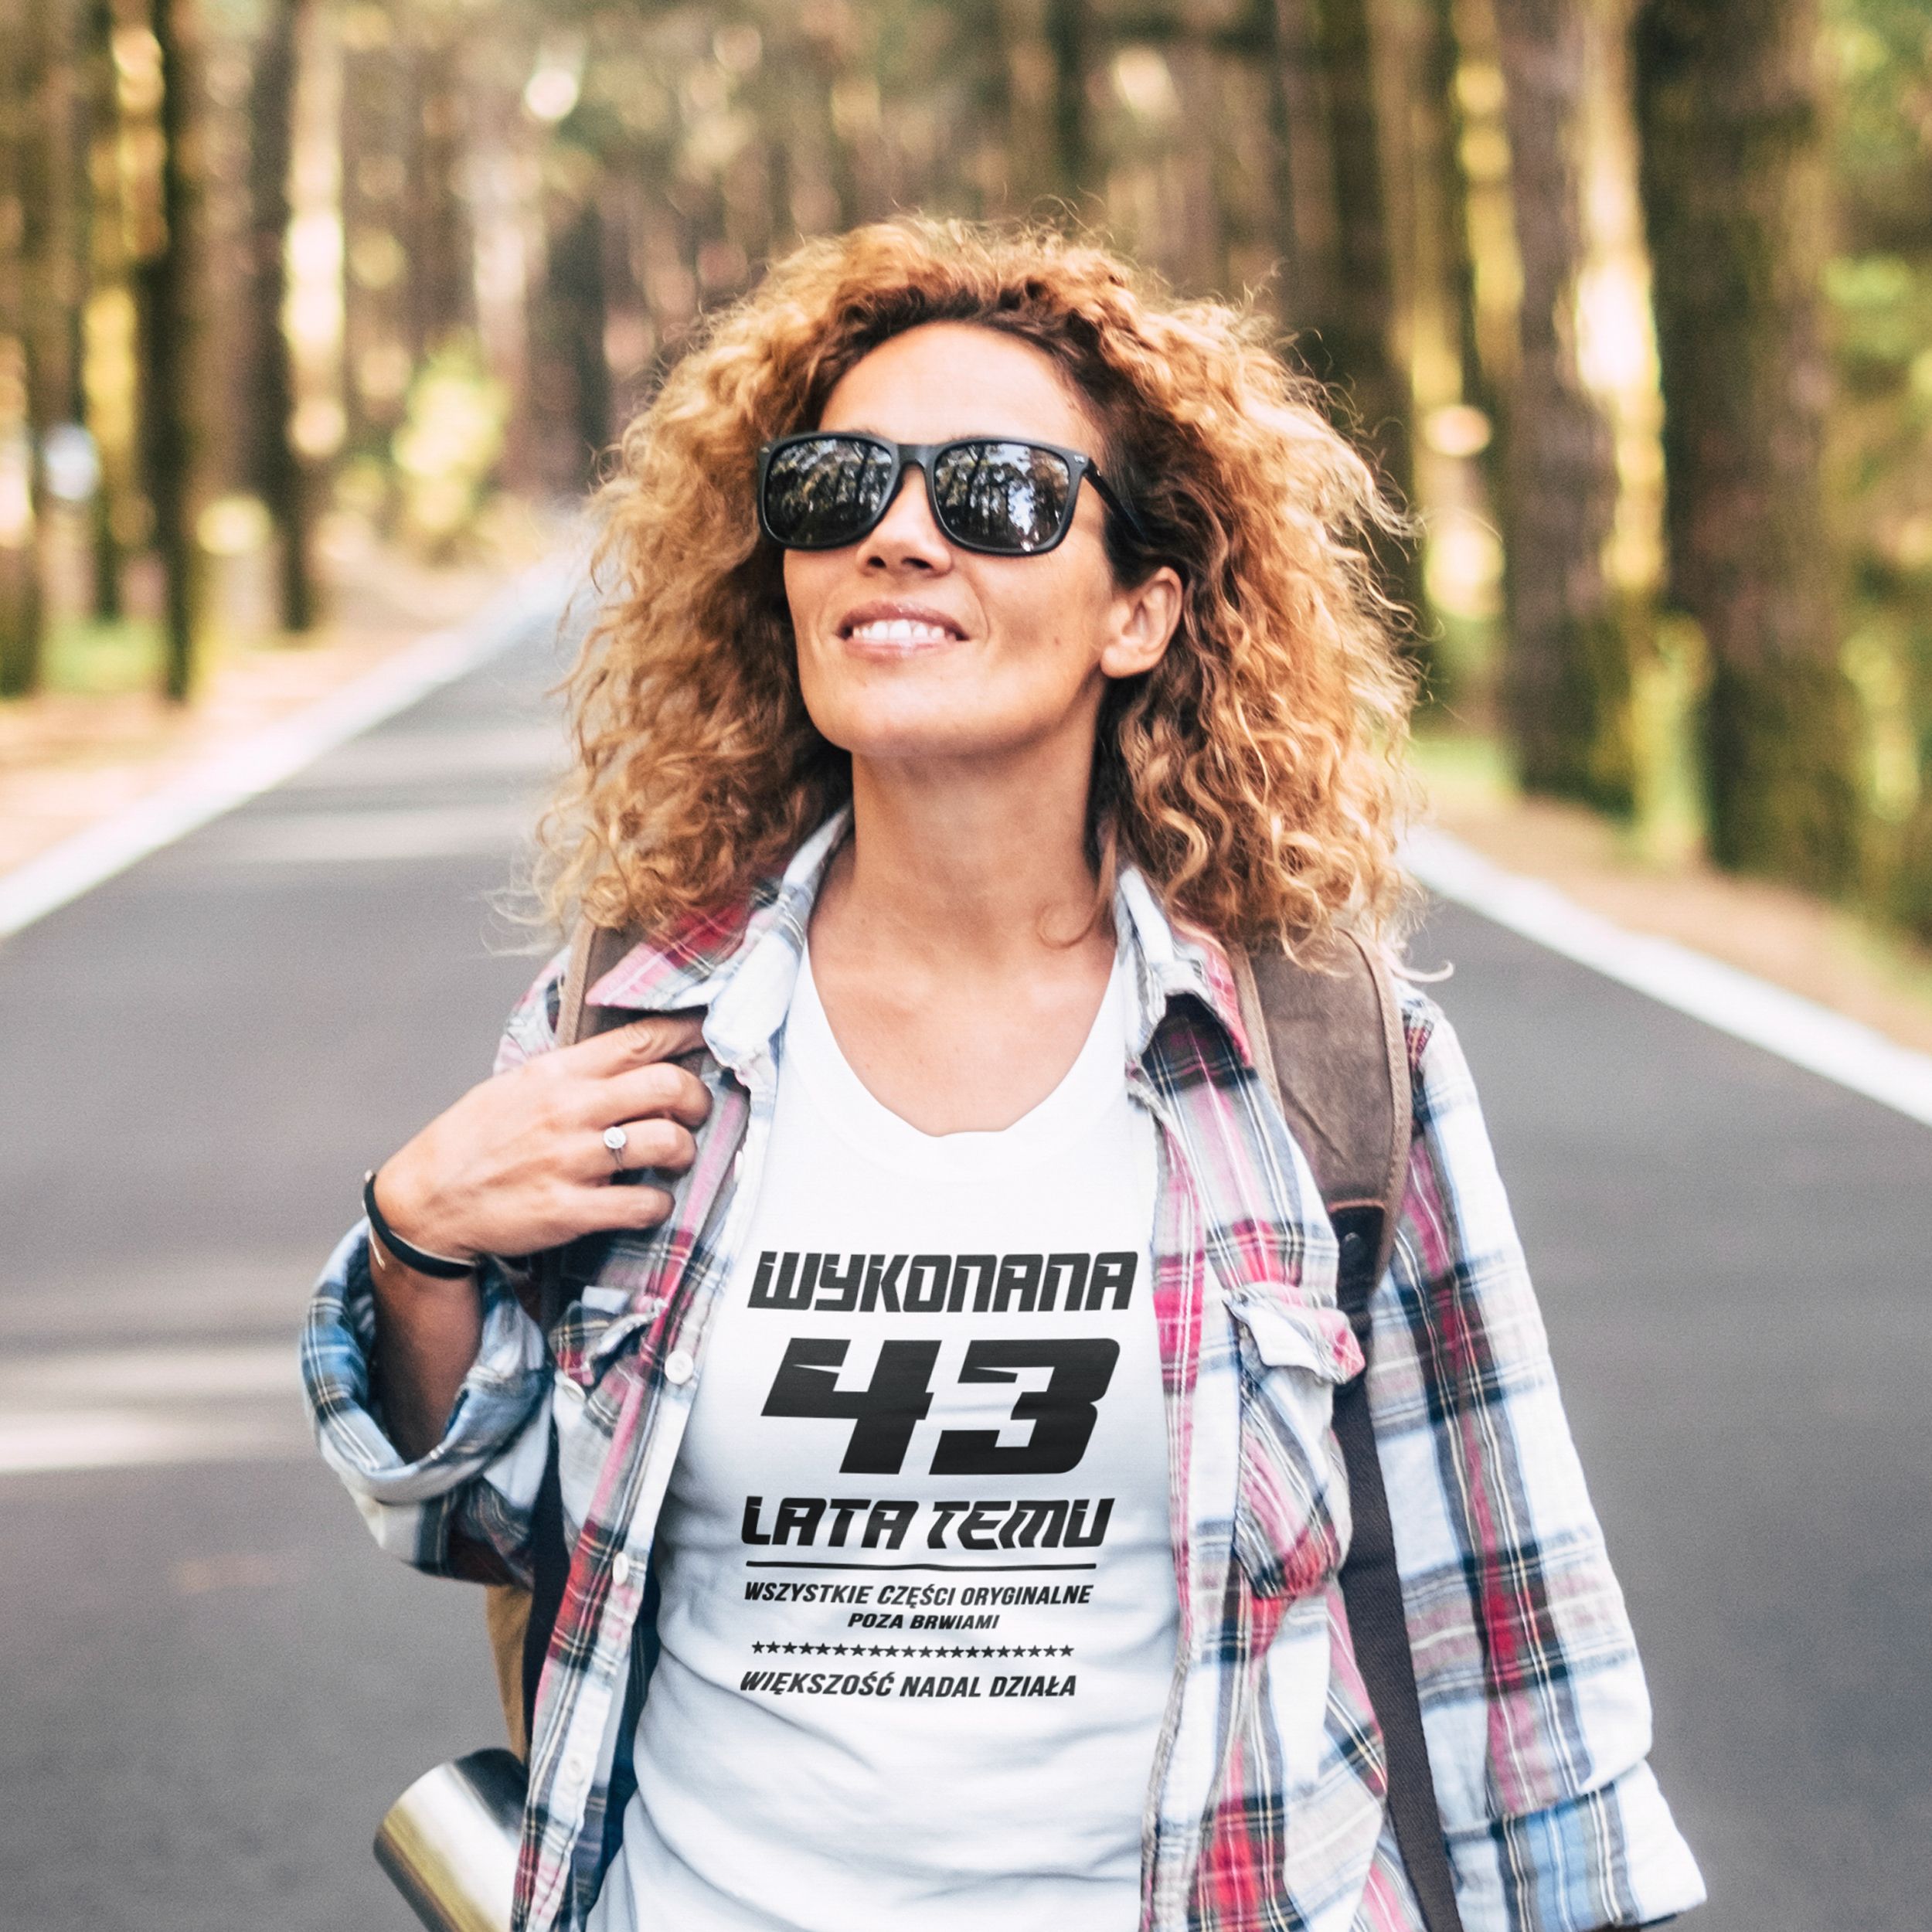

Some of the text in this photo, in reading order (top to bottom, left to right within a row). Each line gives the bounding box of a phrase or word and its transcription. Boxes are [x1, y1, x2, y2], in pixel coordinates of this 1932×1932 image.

[747, 1250, 1138, 1312] WYKONANA
[760, 1337, 1121, 1475] 43
[740, 1495, 1115, 1550] LATA TEMU
[743, 1581, 1094, 1609] WSZYSTKIE CZĘŚCI ORYGINALNE
[846, 1613, 1001, 1630] POZA BRWIAMI
[740, 1670, 1077, 1698] WIĘKSZOŚĆ NADAL DZIAŁA
